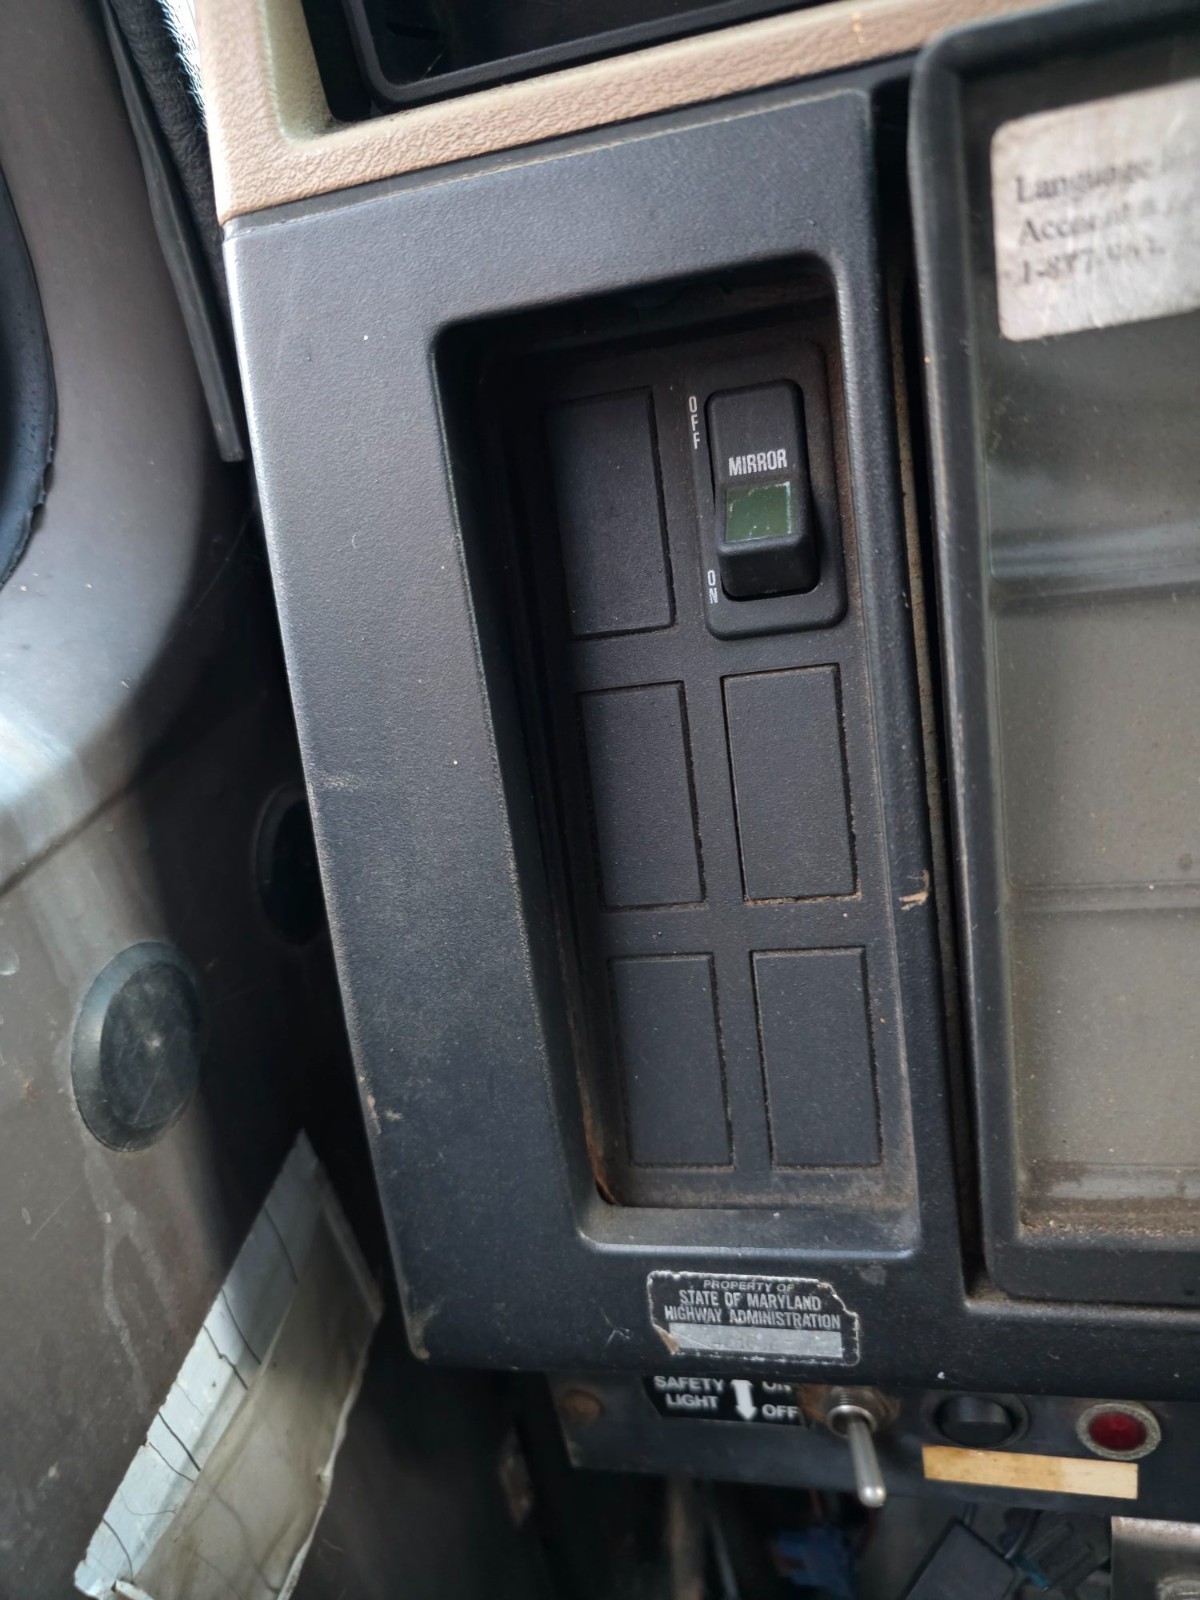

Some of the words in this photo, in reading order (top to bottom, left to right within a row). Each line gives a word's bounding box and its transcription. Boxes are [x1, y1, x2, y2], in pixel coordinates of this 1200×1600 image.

[688, 395, 701, 450] OFF
[729, 448, 788, 477] MIRROR
[707, 569, 719, 604] ON
[704, 1279, 772, 1292] PROPERTY
[777, 1282, 795, 1292] OF
[679, 1289, 720, 1307] STATE
[724, 1291, 741, 1307] OF
[747, 1293, 822, 1311] MARYLAND
[664, 1305, 722, 1323] HIGHWAY
[729, 1309, 840, 1330] ADMINISTRATION
[653, 1375, 725, 1393] SAFETY
[664, 1393, 720, 1410] LIGHT
[761, 1402, 800, 1420] OFF
